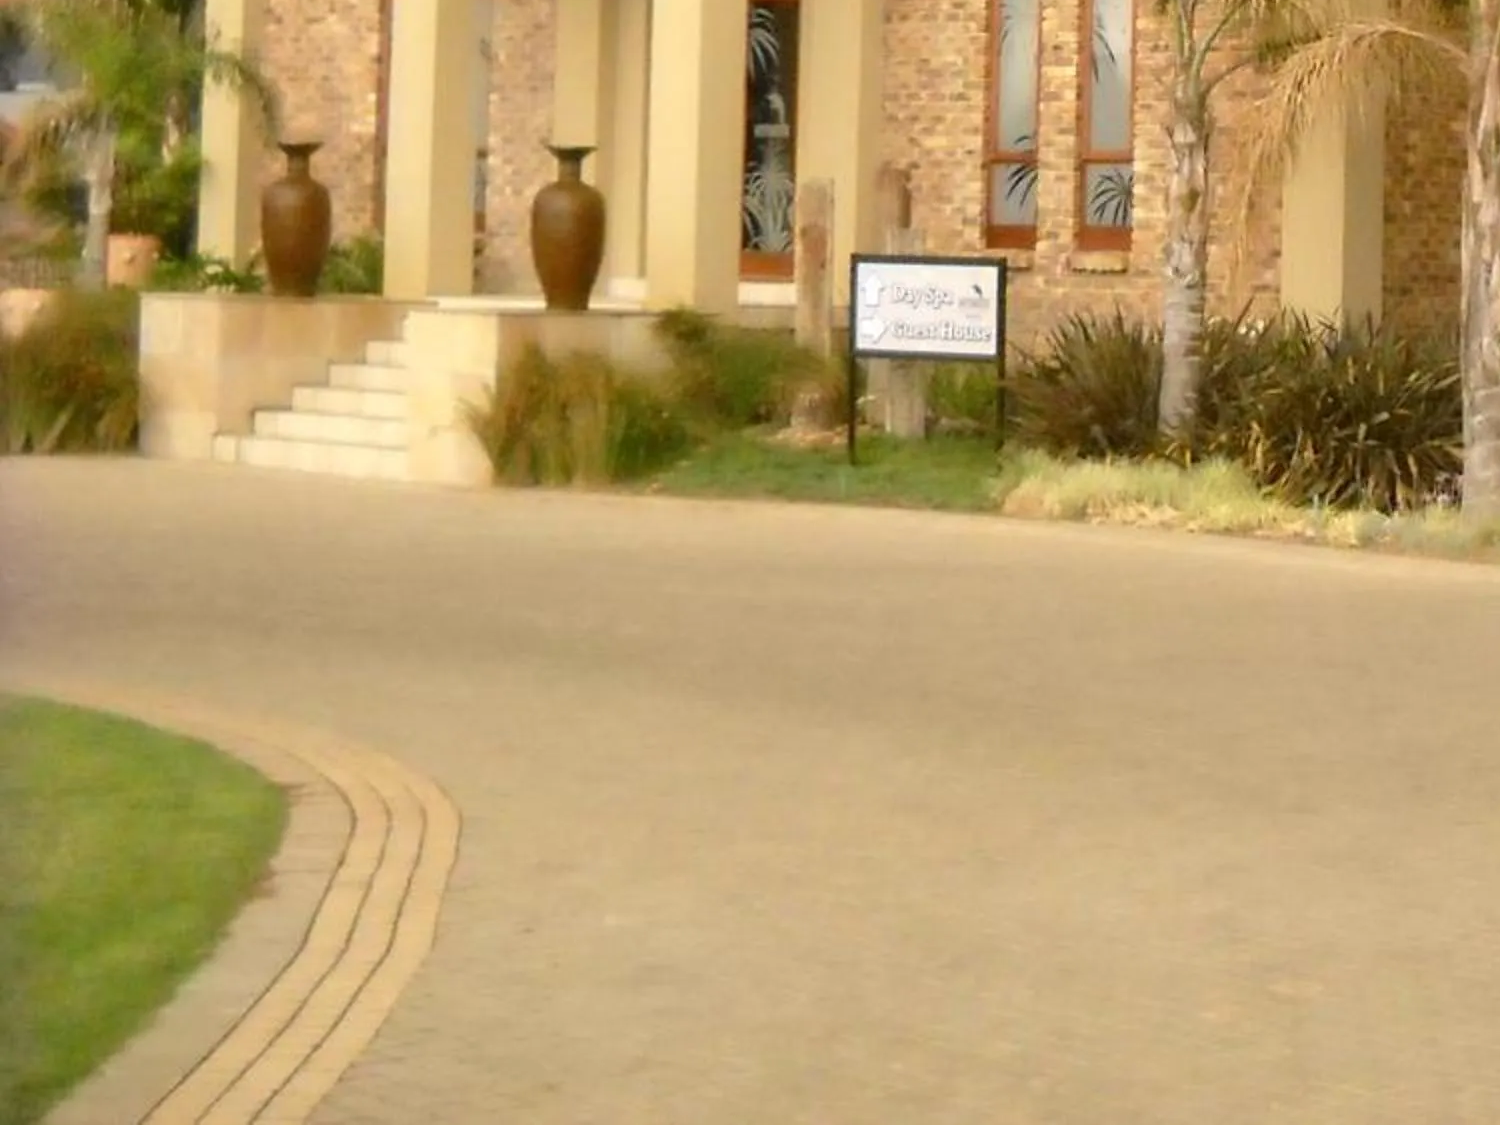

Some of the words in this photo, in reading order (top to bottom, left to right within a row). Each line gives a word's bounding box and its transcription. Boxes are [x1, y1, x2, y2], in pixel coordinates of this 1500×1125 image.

[892, 284, 922, 308] Day
[924, 284, 954, 309] Spa
[940, 321, 992, 342] House
